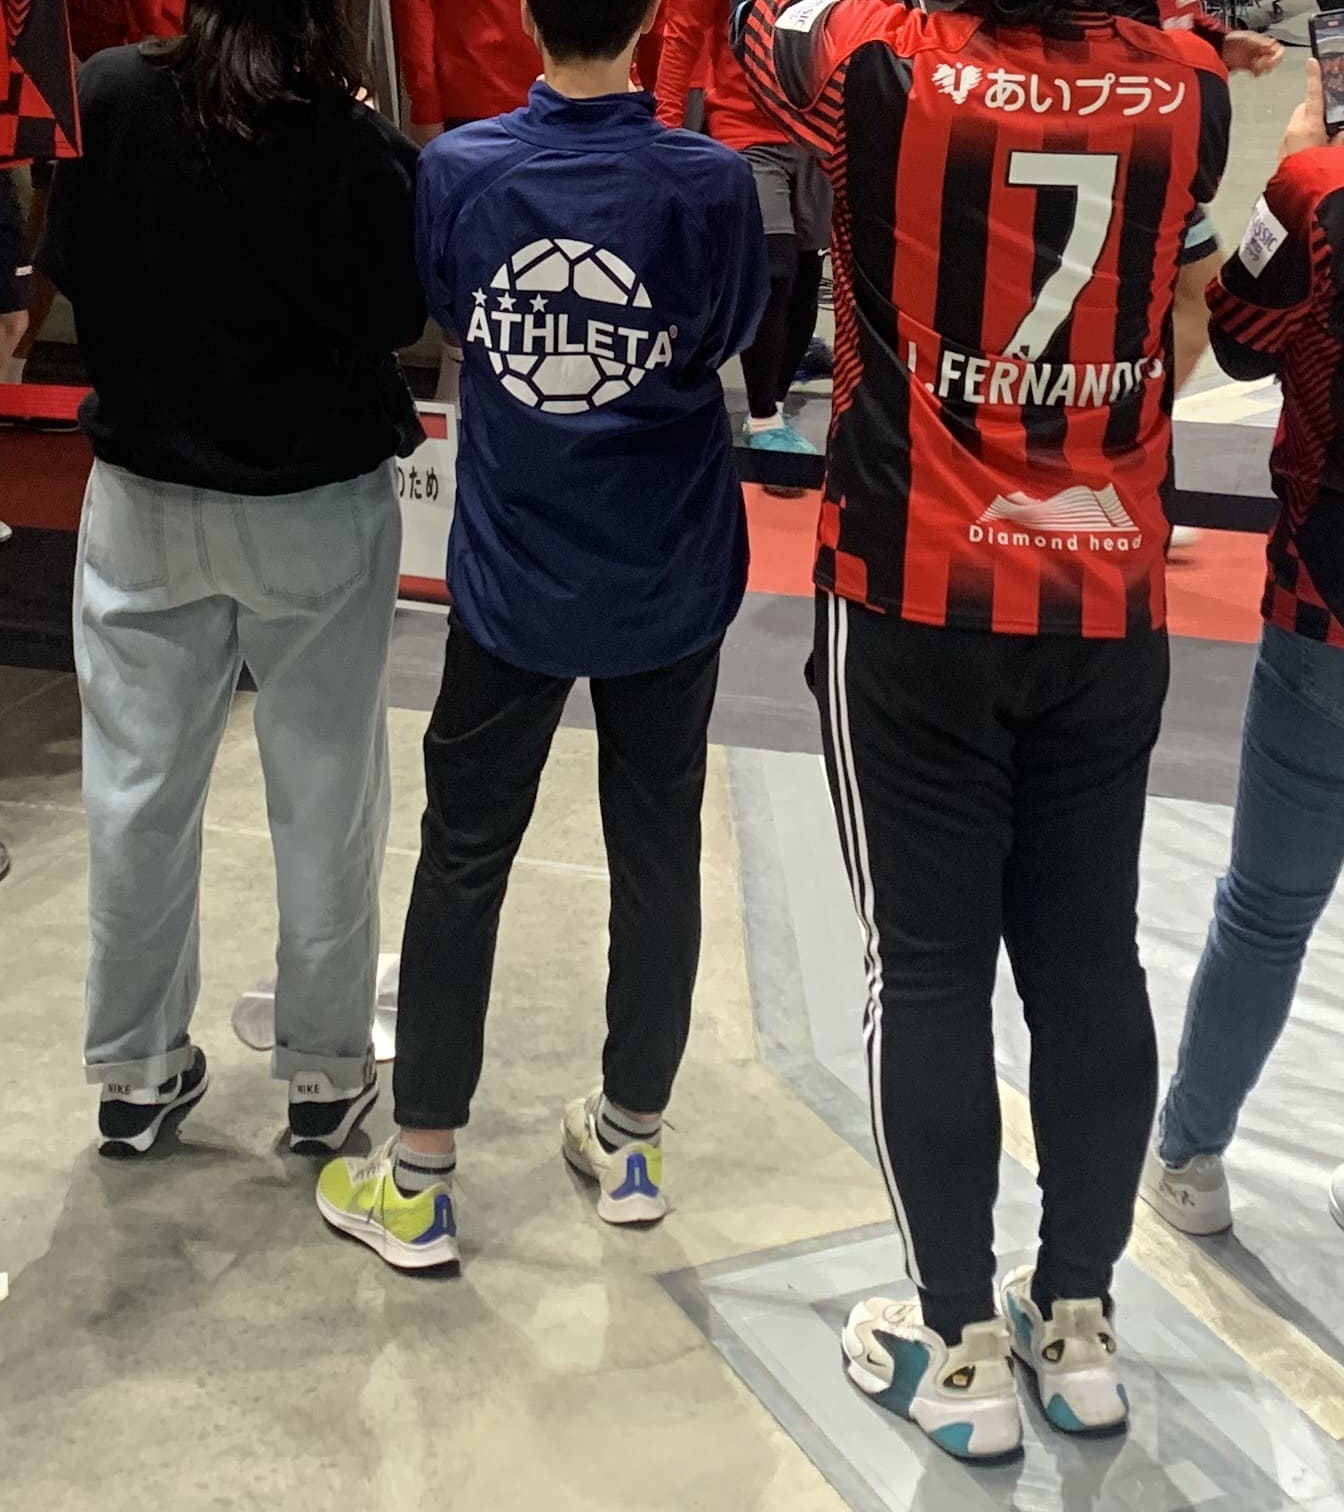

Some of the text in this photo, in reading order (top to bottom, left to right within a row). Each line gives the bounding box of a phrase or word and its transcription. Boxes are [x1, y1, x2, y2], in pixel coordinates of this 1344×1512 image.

[984, 67, 1186, 116] あいプラン
[1003, 151, 1119, 363] 7
[466, 305, 678, 370] ATHLETA
[969, 525, 1143, 551] Diamond head
[107, 1083, 131, 1095] NIKE
[296, 1083, 320, 1095] NIKE
